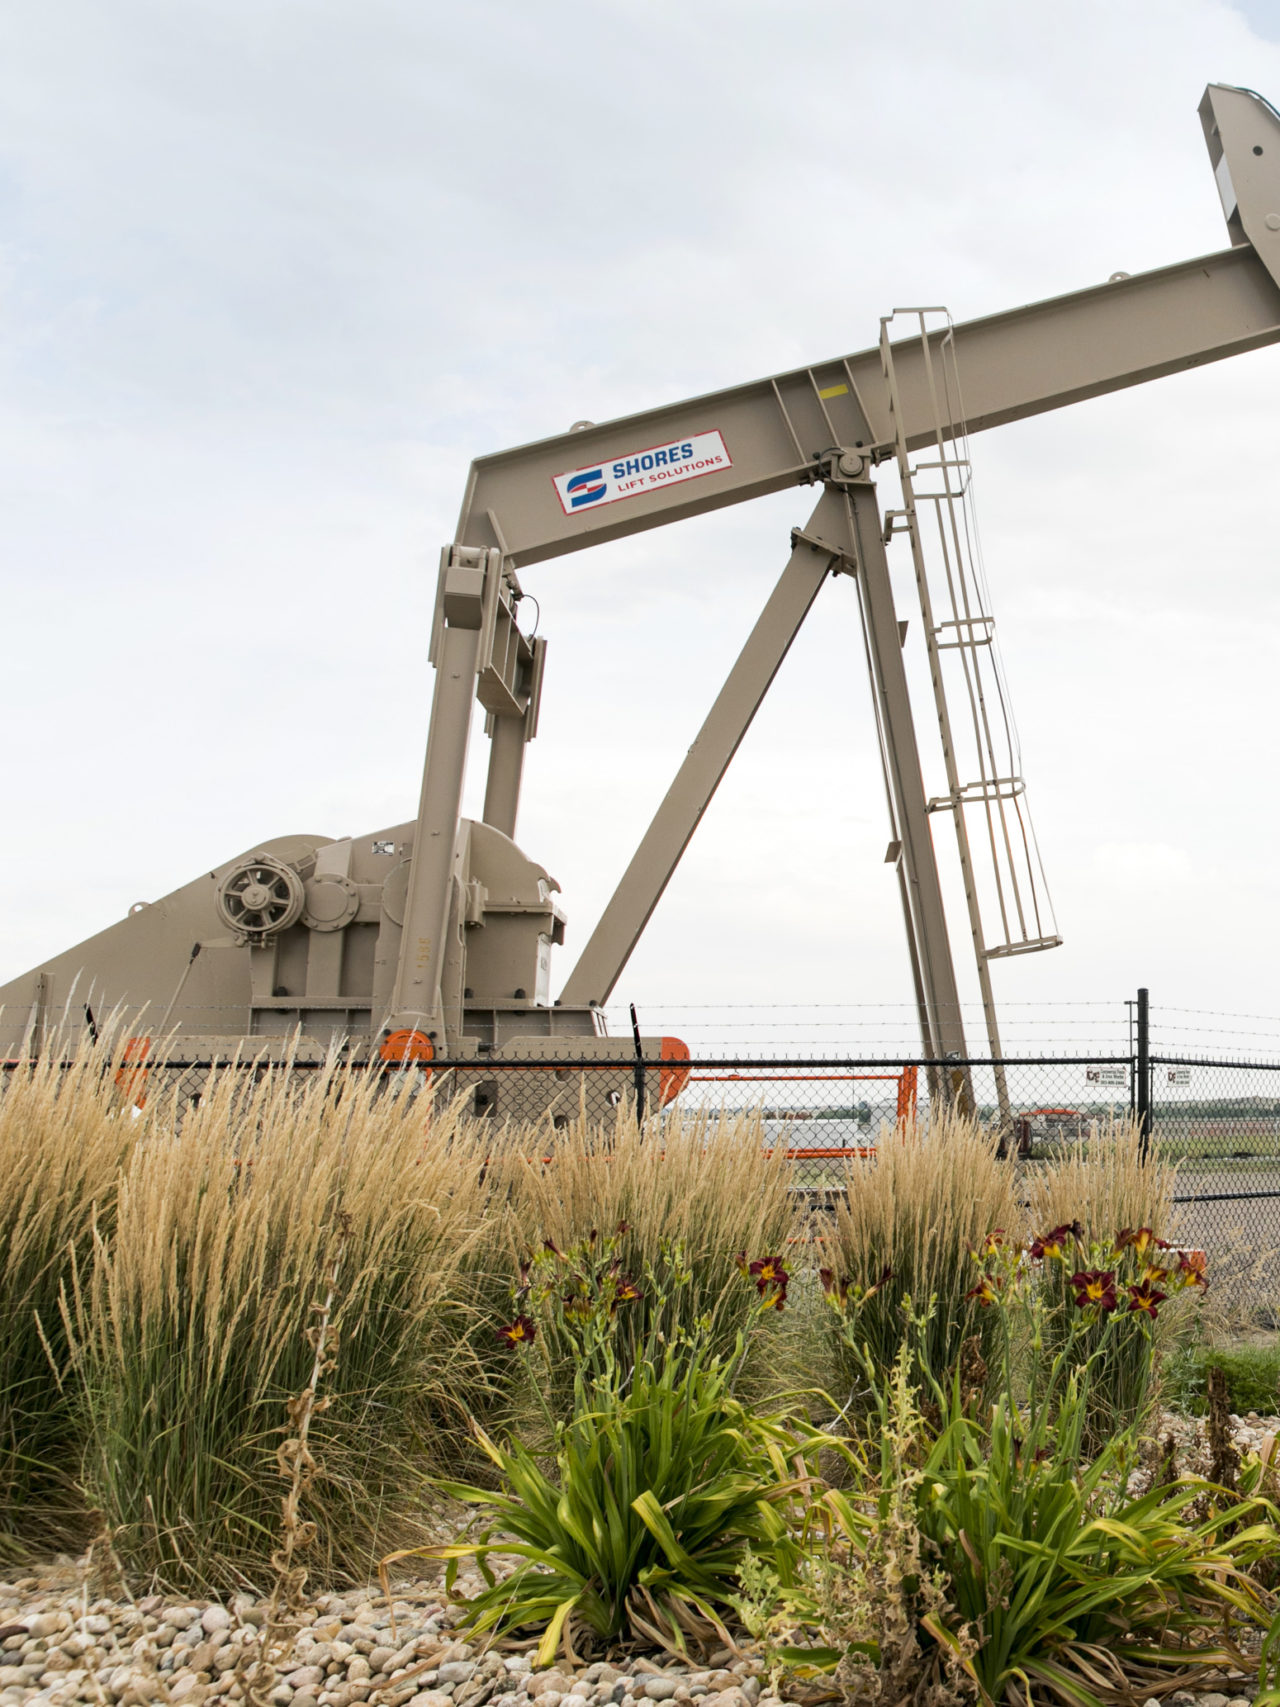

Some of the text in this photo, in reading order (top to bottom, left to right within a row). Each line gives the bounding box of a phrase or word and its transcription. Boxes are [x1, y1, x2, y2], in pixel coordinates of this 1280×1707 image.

[613, 443, 693, 479] SHORES
[618, 455, 723, 491] LIFT SOLUTIONS
